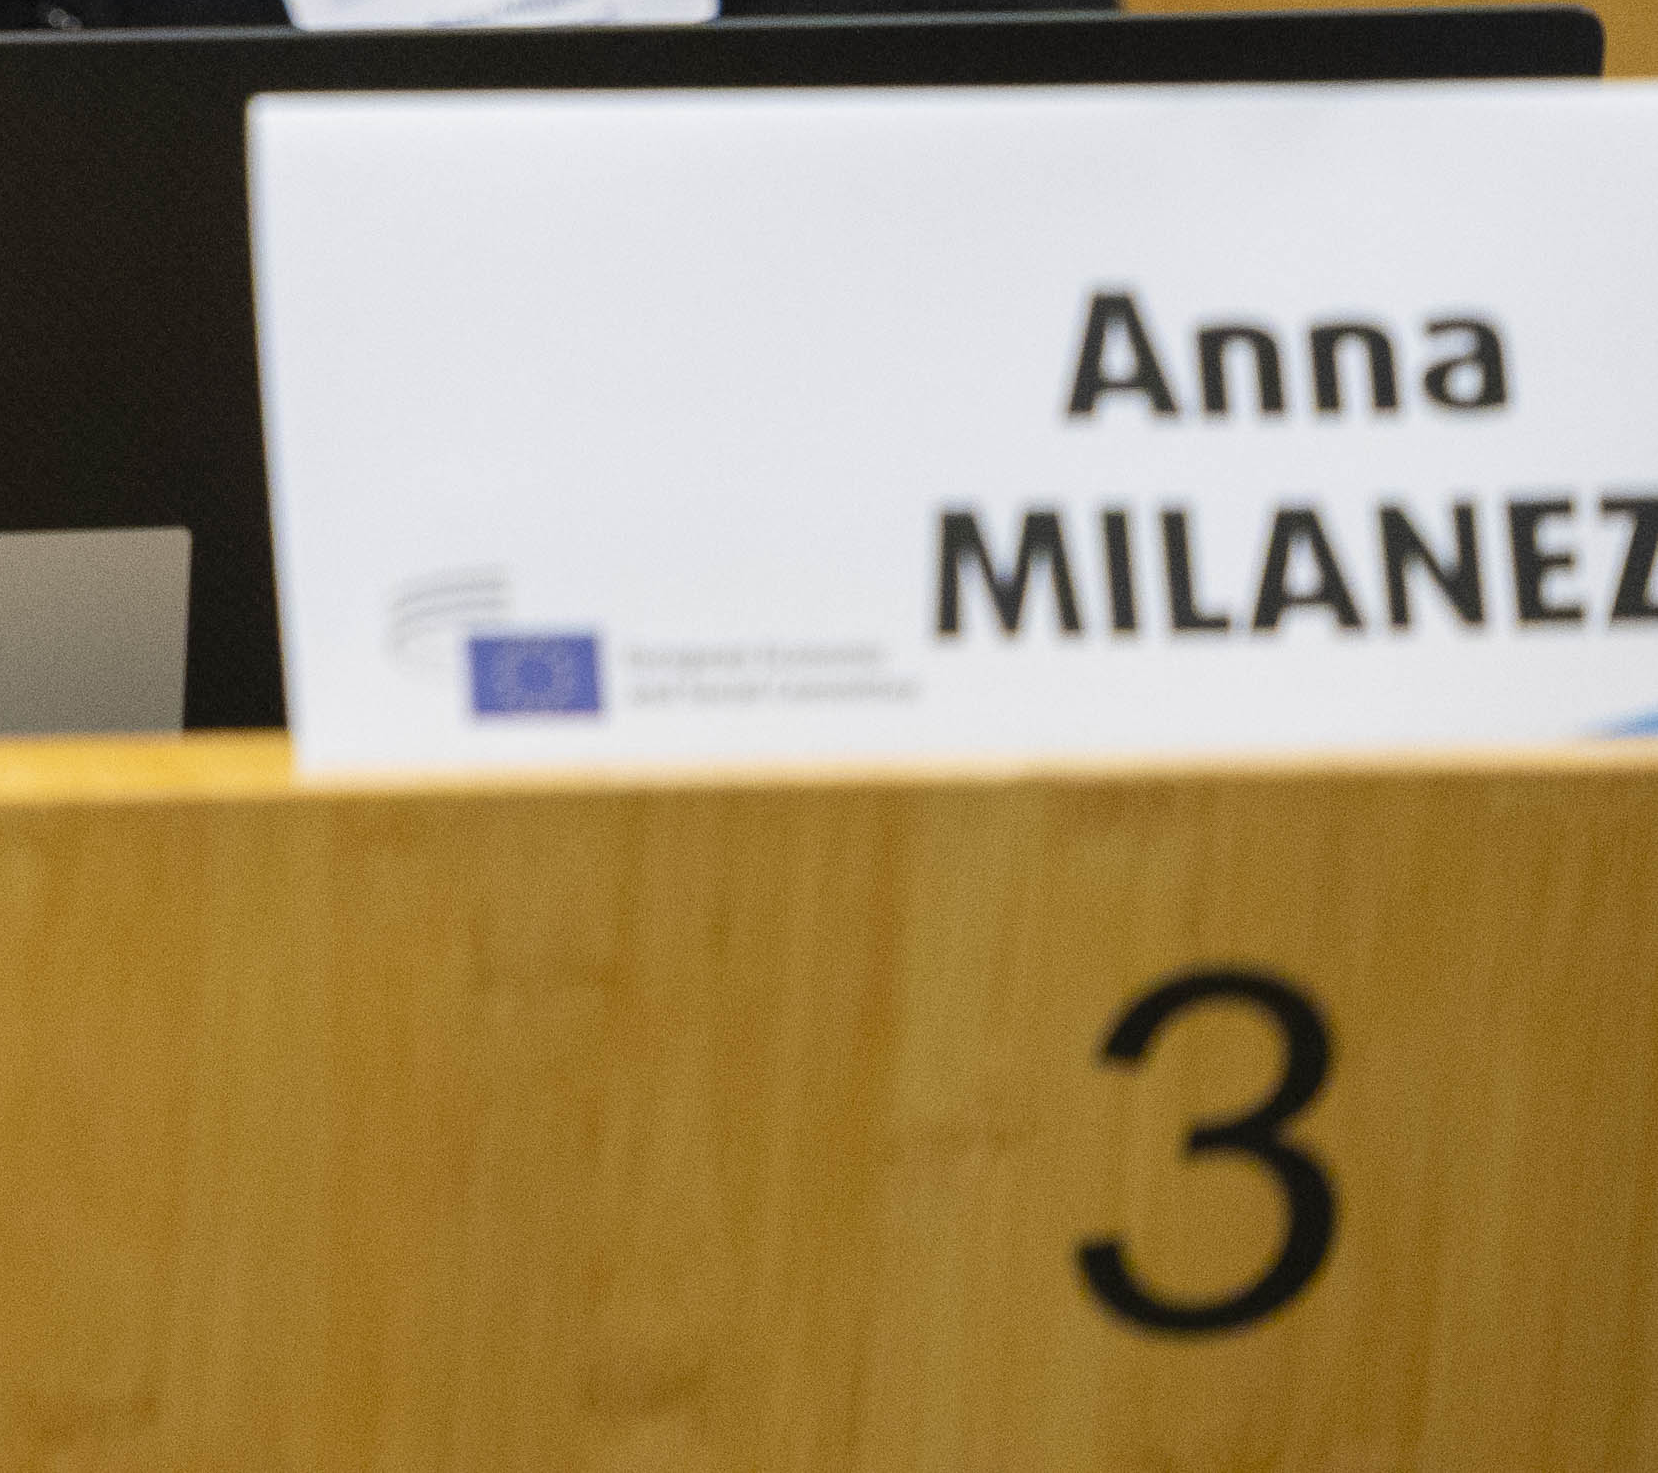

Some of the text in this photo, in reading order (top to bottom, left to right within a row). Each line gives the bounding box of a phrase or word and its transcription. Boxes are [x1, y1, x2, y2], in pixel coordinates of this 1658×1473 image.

[1065, 291, 1510, 419] Anna
[935, 491, 1658, 639] MILANEZ
[1077, 965, 1340, 1341] 3
